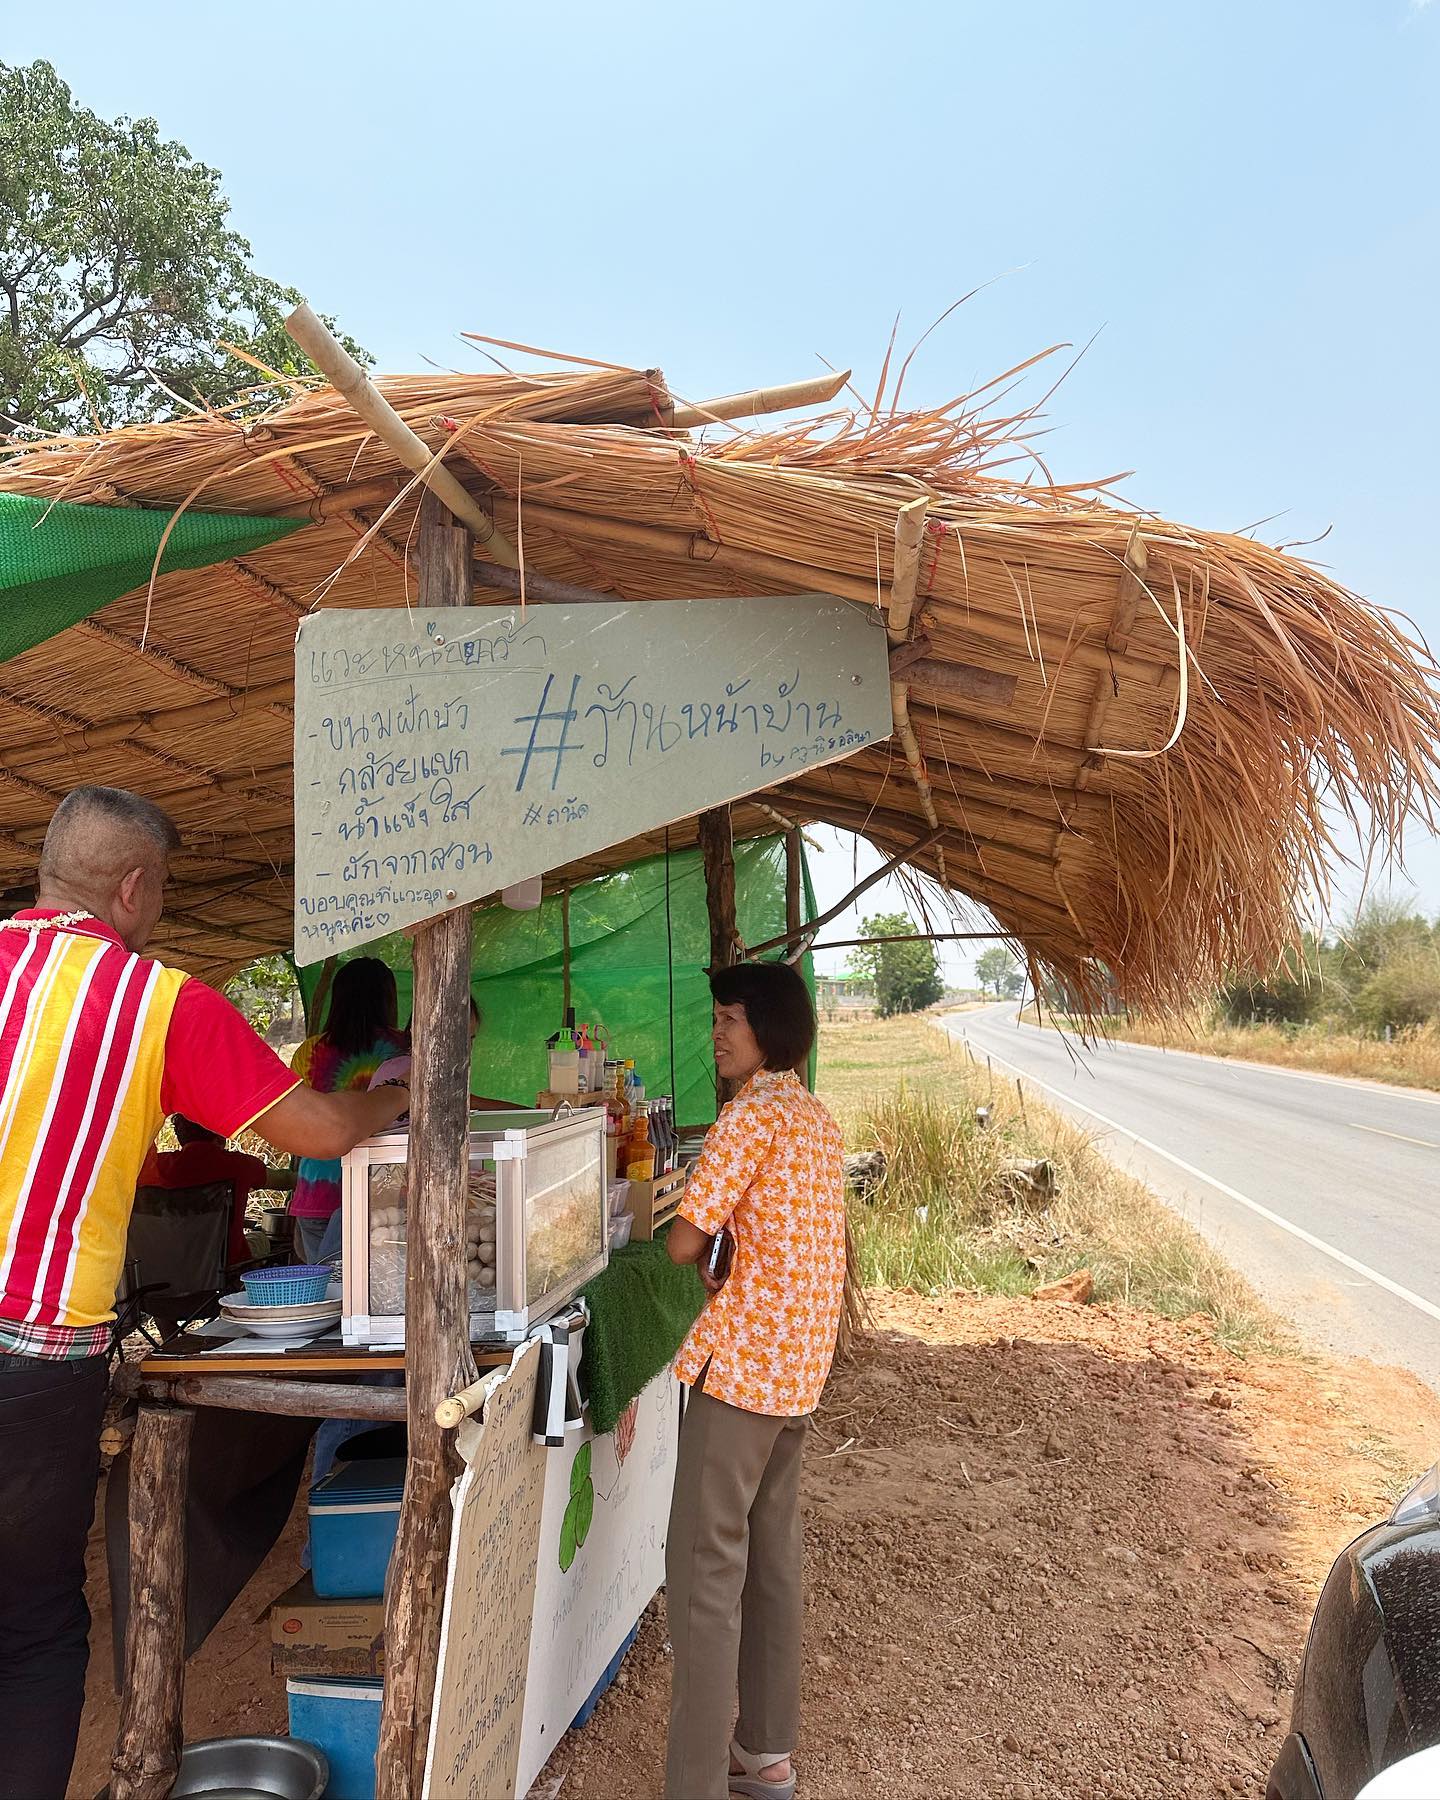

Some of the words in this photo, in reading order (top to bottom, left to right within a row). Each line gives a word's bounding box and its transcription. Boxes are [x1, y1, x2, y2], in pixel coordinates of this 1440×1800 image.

[338, 750, 470, 794] กล้วยแขก
[343, 841, 493, 882] ผักจากสวน
